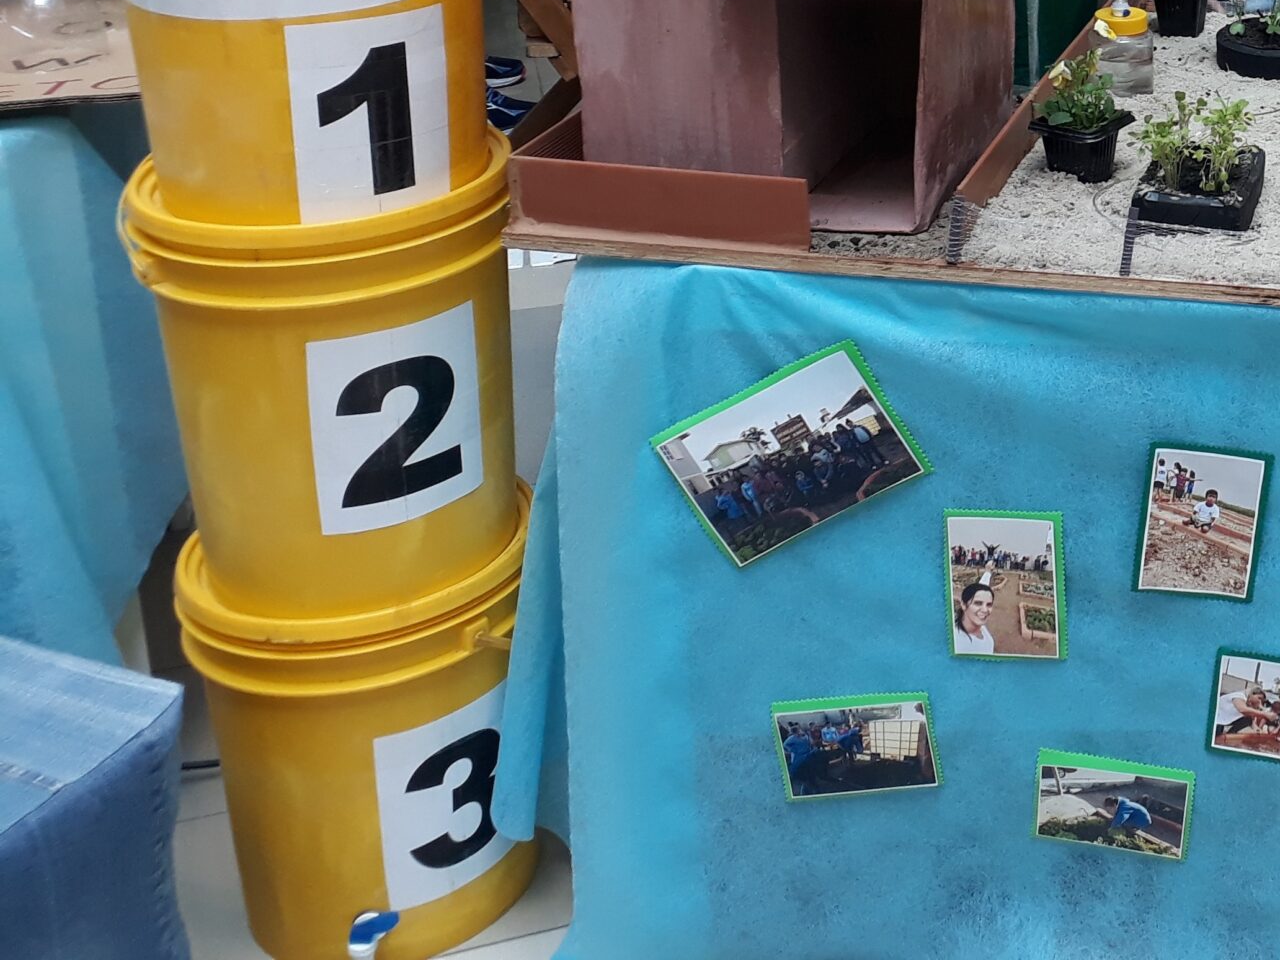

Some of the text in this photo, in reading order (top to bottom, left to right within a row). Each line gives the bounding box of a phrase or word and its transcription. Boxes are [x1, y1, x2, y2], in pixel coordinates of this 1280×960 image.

[316, 41, 417, 196] 1
[335, 355, 463, 509] 2
[405, 728, 500, 869] 3
